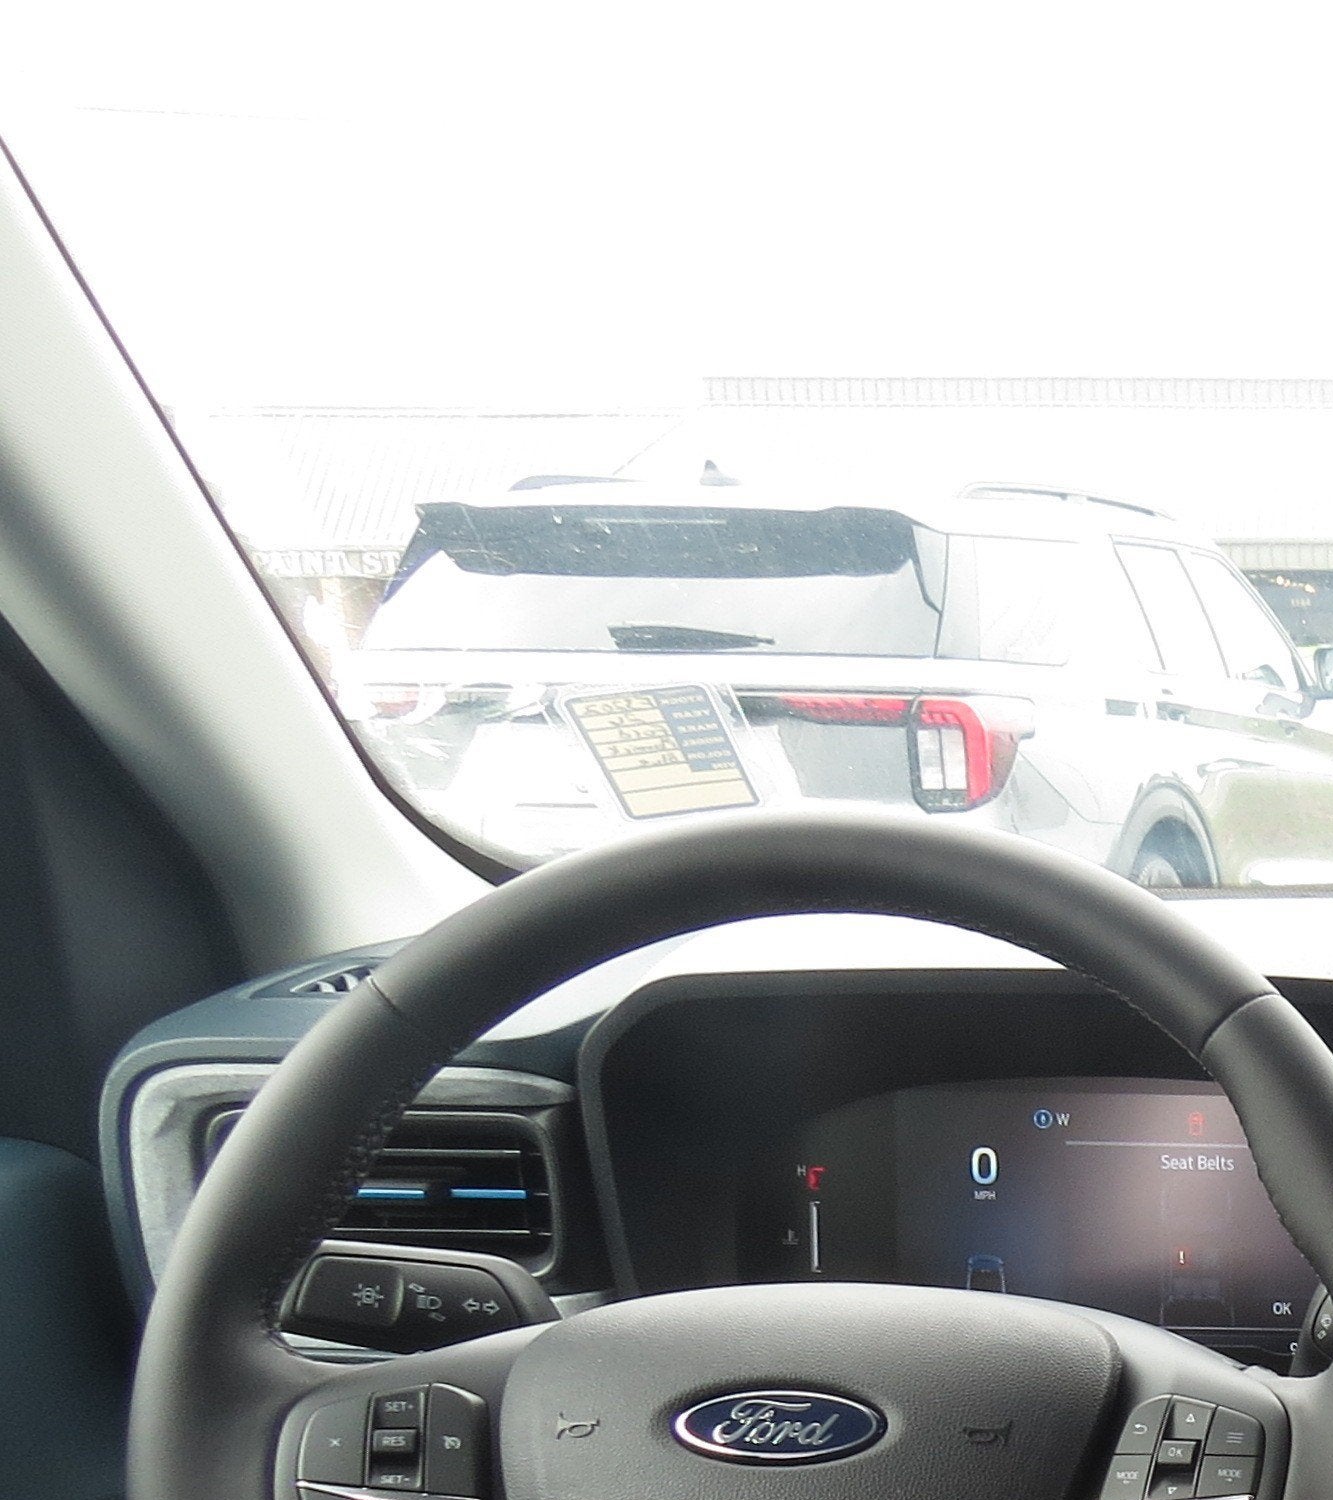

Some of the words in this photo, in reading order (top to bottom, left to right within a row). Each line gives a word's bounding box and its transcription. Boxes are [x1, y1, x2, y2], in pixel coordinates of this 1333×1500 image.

[1055, 1112, 1071, 1127] W
[970, 1146, 999, 1186] 0
[1160, 1154, 1194, 1171] Seat
[1197, 1155, 1235, 1172] Belts
[973, 1190, 997, 1201] MPH
[1272, 1301, 1293, 1315] OK
[711, 1398, 840, 1446] Ford
[381, 1435, 406, 1447] RES
[1167, 1447, 1184, 1458] OK
[1116, 1470, 1139, 1481] MODE
[1217, 1468, 1243, 1479] MODE
